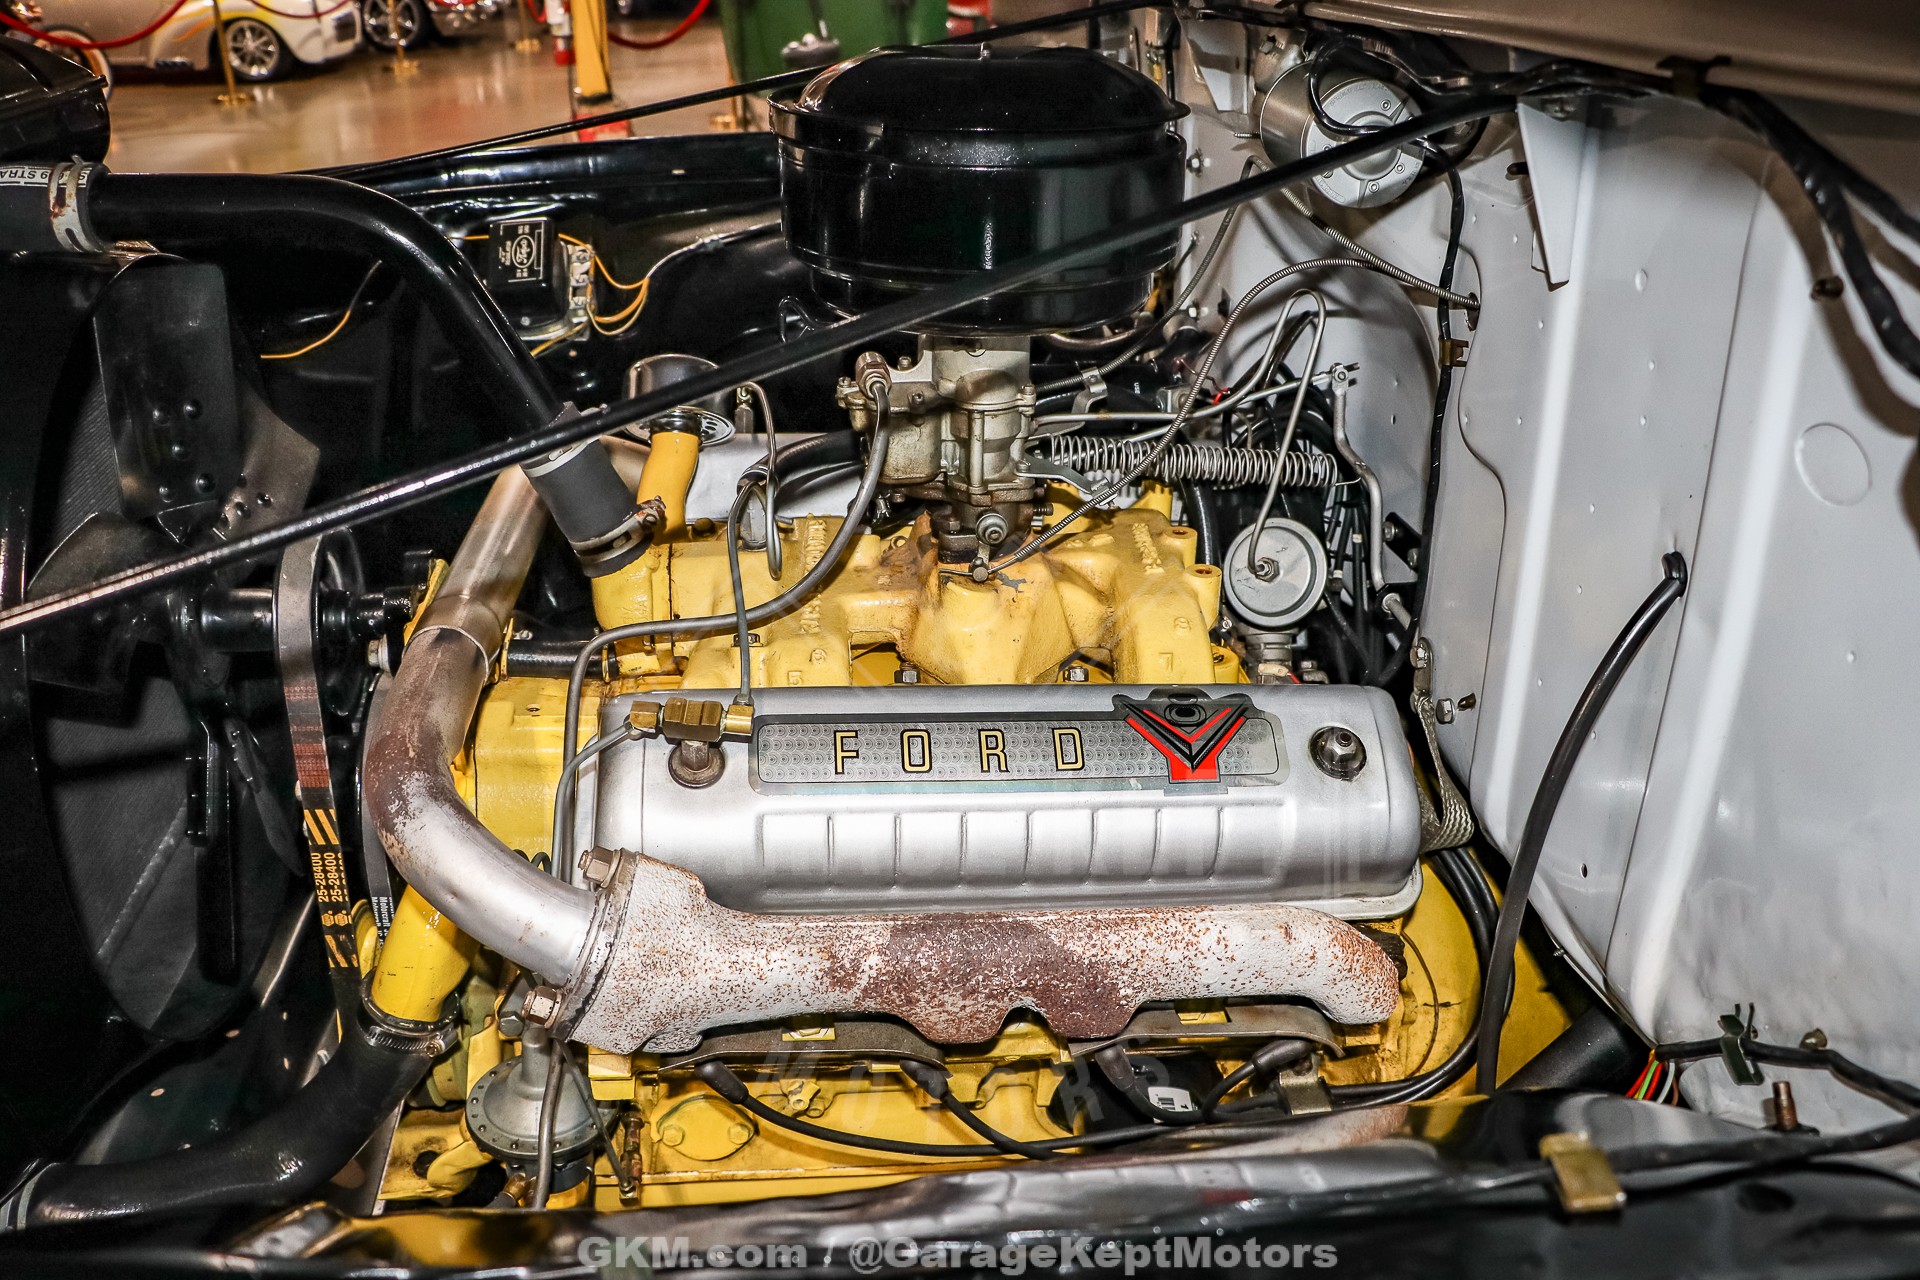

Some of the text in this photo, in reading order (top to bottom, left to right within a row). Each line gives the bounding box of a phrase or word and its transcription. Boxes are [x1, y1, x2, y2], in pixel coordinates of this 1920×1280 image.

[833, 727, 1084, 775] FORD
[311, 852, 330, 902] 25-28400
[324, 852, 344, 902] 25-28400
[379, 896, 391, 927] Motorcraft
